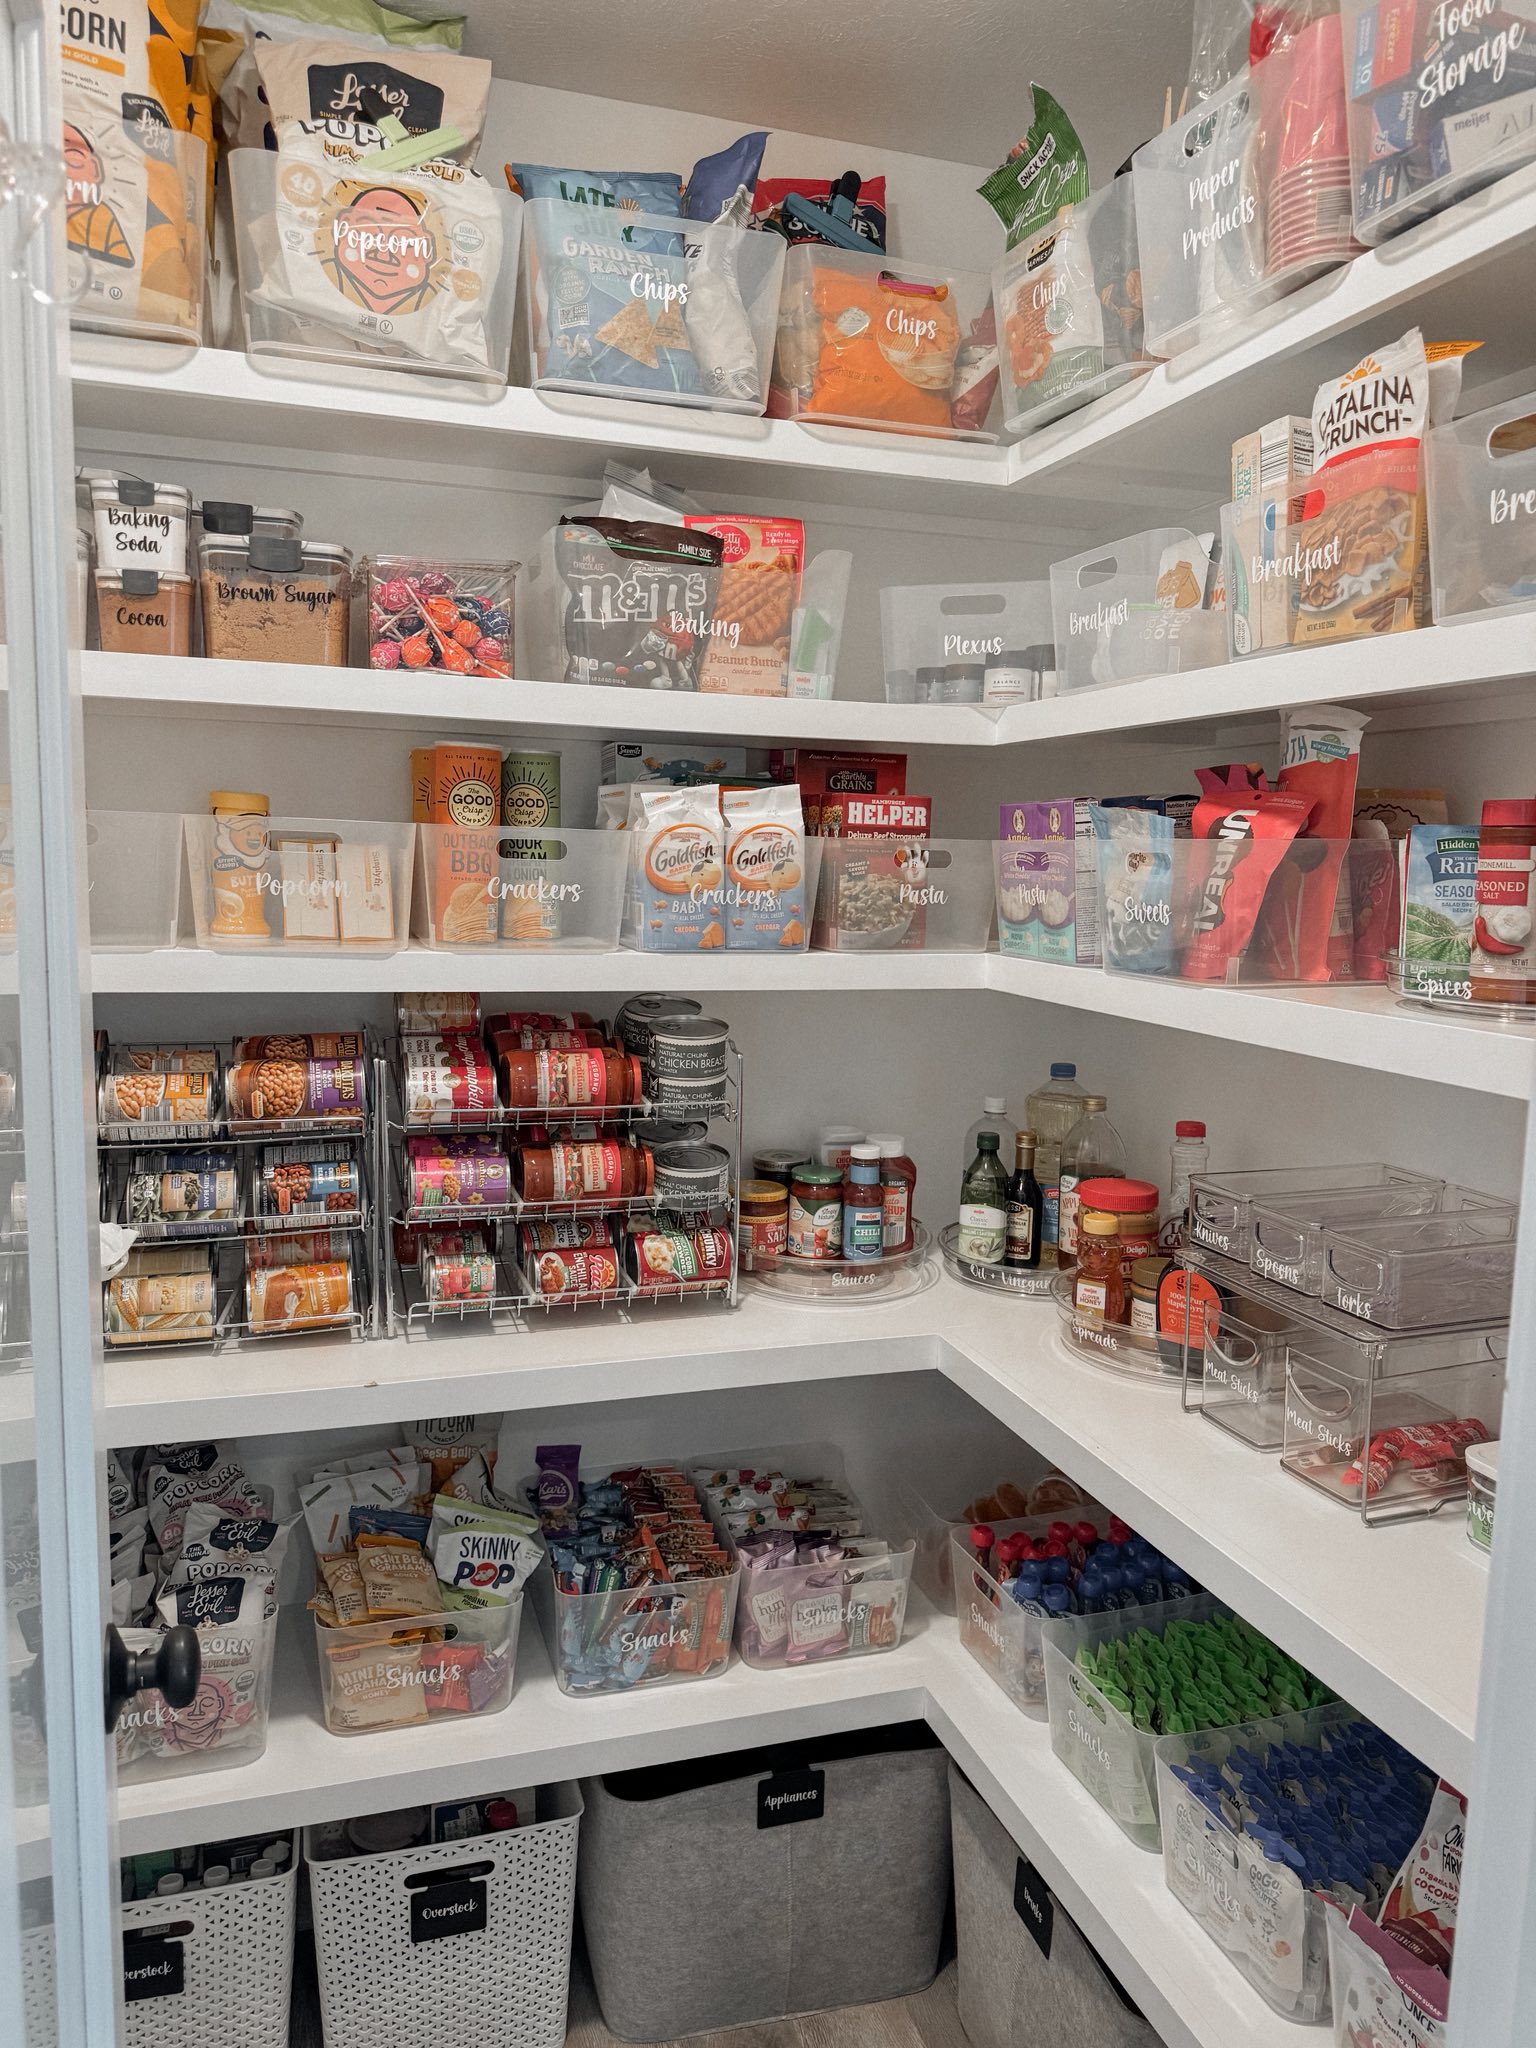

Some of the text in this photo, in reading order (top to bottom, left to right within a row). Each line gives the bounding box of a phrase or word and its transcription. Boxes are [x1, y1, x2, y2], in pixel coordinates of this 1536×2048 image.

[60, 3, 126, 55] ORN
[1385, 6, 1401, 63] Freezer
[1416, 22, 1527, 109] Storage
[319, 110, 343, 121] SIMPLE
[1453, 109, 1492, 133] meijer
[407, 126, 428, 134] CLEAN
[1018, 160, 1042, 187] SNACK
[1188, 158, 1241, 212] Paper
[559, 180, 617, 209] LATE
[1180, 192, 1258, 263] Products
[332, 219, 434, 264] Popcorn
[562, 236, 655, 267] GARDEN
[588, 256, 672, 284] RANCH
[629, 272, 692, 313] Chips
[1031, 271, 1069, 313] Chips
[885, 307, 939, 347] Chips
[1317, 376, 1416, 439] CATALINA
[1488, 485, 1536, 526] Bre
[107, 506, 173, 537] Baking
[115, 532, 163, 555] Soda
[677, 542, 713, 560] FAMILY SIZE
[1250, 535, 1342, 586] Breakfast
[217, 580, 338, 612] Brown Sugar
[115, 606, 169, 629] Cocoa
[669, 610, 744, 650] Baking
[1068, 597, 1132, 639] Breakfast
[943, 633, 1007, 657] Plexus
[708, 652, 785, 669] Peanut Butter
[829, 774, 874, 791] GRAINS
[841, 771, 867, 782] earthly
[452, 793, 494, 807] GOOD
[467, 787, 481, 796] The
[506, 797, 546, 809] GOOD
[517, 791, 531, 799] The
[871, 798, 906, 806] HAMBURGER
[456, 811, 490, 825] COMPANY
[462, 805, 485, 817] Crisp
[509, 814, 542, 827] COMPANY
[514, 808, 536, 819] Crisp
[847, 801, 928, 828] HELPER
[507, 837, 543, 851] SOUR
[847, 830, 928, 843] Deluxe Beef Stroganoff
[1439, 840, 1476, 851] Hidden
[450, 849, 493, 877] BBQ
[505, 851, 548, 867] CREAM
[654, 840, 716, 873] Goldfish
[736, 842, 797, 872] Goldfish
[1439, 857, 1478, 875] Ran
[513, 866, 548, 881] ONION
[1190, 809, 1260, 938] UNREAL
[1475, 881, 1525, 892] EASONED
[255, 871, 353, 909] Popcorn
[486, 874, 585, 904] Crackers
[689, 881, 778, 909] Crackers
[899, 883, 949, 906] Pasta
[1017, 882, 1049, 907] Pasta
[1434, 884, 1477, 898] SEASO
[1482, 891, 1500, 900] SALT
[671, 899, 704, 915] BABY
[752, 896, 784, 913] BABY
[1123, 896, 1173, 927] Sweets
[673, 925, 701, 934] CHEDDAR
[754, 924, 782, 932] CHEDDAR
[1416, 968, 1477, 1003] Spices
[658, 1054, 725, 1070] CHICKEN BREAST
[686, 1051, 710, 1059] CHUNK
[338, 1060, 356, 1101] DAKOTA'S
[573, 1053, 588, 1103] Traditional
[589, 1059, 602, 1094] REGGANO
[691, 1092, 713, 1100] CHUNK
[477, 1158, 488, 1189] Annie's
[588, 1143, 602, 1192] Traditional
[603, 1147, 617, 1182] REGGANO
[202, 1188, 211, 1208] BEANS
[675, 1183, 698, 1191] CHUNK
[556, 1223, 567, 1244] Rice
[854, 1227, 881, 1237] CHILI
[1193, 1221, 1232, 1251] Knives
[672, 1236, 688, 1277] CHOWDER
[699, 1227, 718, 1267] CHUNKY
[1125, 1245, 1149, 1255] Delight
[568, 1265, 578, 1289] SAUCE
[572, 1251, 589, 1298] ENCHILADA
[588, 1254, 605, 1292] Pac
[830, 1271, 878, 1288] Sauces
[969, 1262, 1052, 1295] Oil Vinegar
[1255, 1248, 1300, 1285] Spoons
[316, 1269, 331, 1315] PUMPKIN
[1078, 1297, 1102, 1307] HONEY
[1081, 1293, 1100, 1301] CLOVER
[1335, 1285, 1374, 1320] Forks
[1071, 1314, 1120, 1351] Spreads
[1204, 1357, 1261, 1403] Meat Sticks
[1285, 1405, 1316, 1436] Meat
[1317, 1423, 1354, 1457] Sticks
[162, 1463, 244, 1507] POPCORN
[226, 1525, 260, 1543] Evil
[188, 1545, 204, 1553] THE
[368, 1552, 401, 1570] MINI
[452, 1560, 517, 1590] POP
[186, 1582, 229, 1609] Lesser
[194, 1598, 224, 1618] Evil
[801, 1603, 870, 1628] Snacks
[969, 1602, 1013, 1654] Snacks
[200, 1636, 256, 1657] CORN
[620, 1625, 692, 1653] Snacks
[337, 1665, 375, 1690] MINI
[385, 1659, 465, 1691] Snacks
[361, 1687, 392, 1701] HONEY
[114, 1700, 182, 1731] nacks
[1066, 1708, 1114, 1772] Snacks
[763, 1789, 819, 1812] Appliances
[1183, 1840, 1242, 1922] Snacks
[421, 1897, 479, 1921] Overstock
[123, 1960, 175, 1983] verstock
[1395, 1974, 1444, 2017] NO ADDED SUGAR
